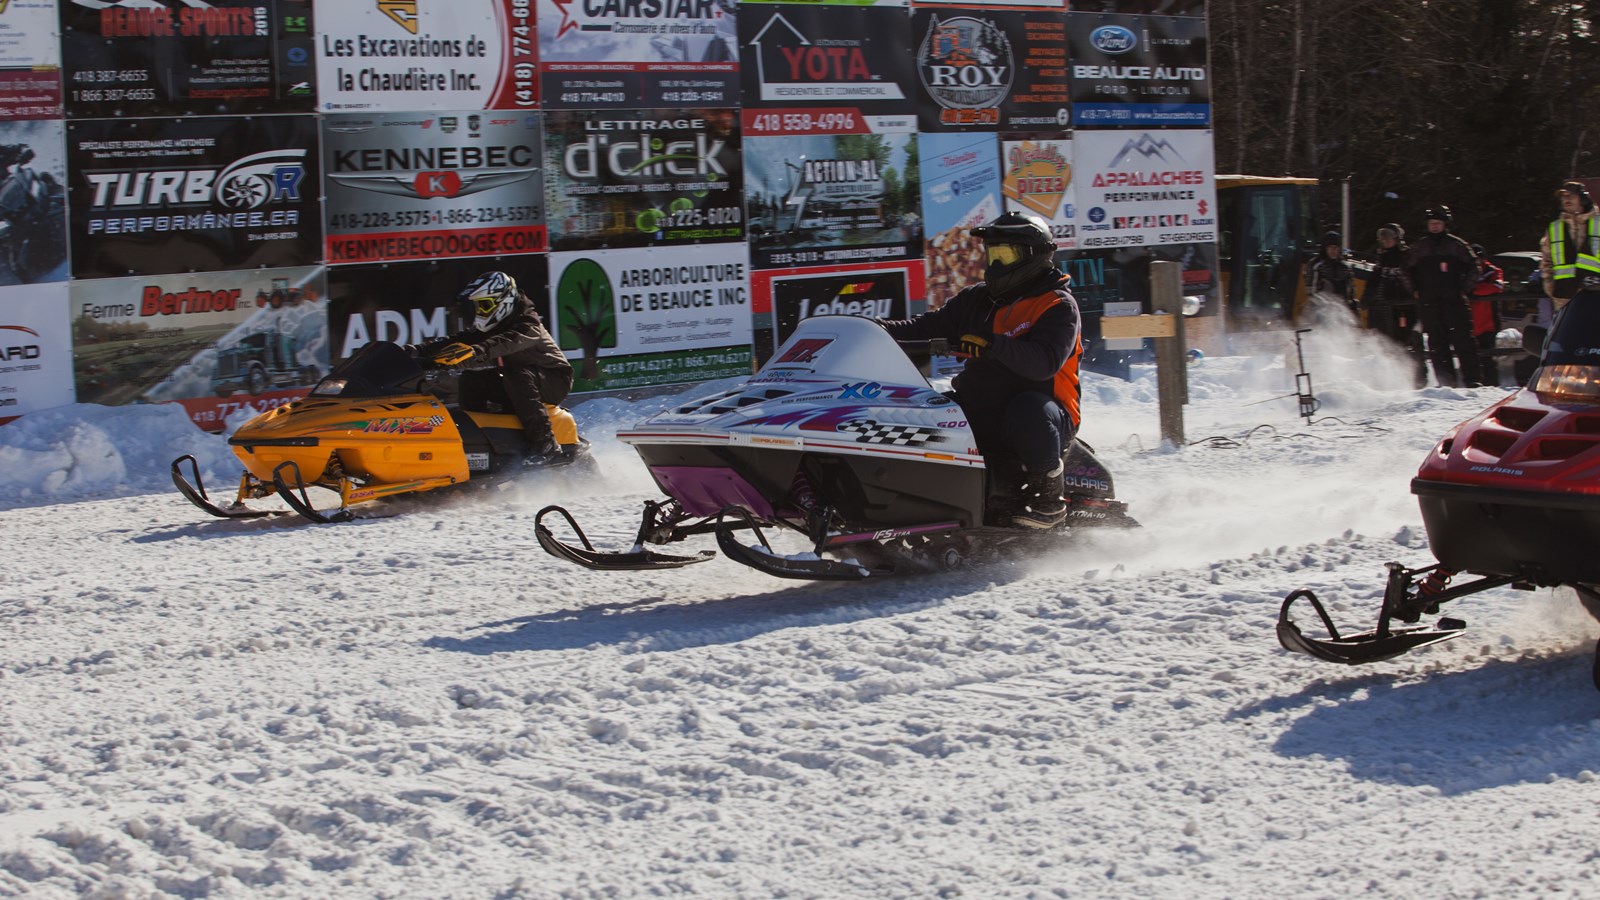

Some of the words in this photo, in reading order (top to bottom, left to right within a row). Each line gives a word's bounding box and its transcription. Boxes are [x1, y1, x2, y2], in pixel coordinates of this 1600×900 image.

[584, 0, 714, 18] CARSTAR
[101, 7, 174, 36] BEAUCE
[180, 7, 253, 36] SPORTS
[323, 34, 354, 57] Les
[358, 33, 461, 57] Excavations
[466, 34, 486, 57] de
[1099, 30, 1129, 48] Ford
[781, 47, 871, 81] YOTA
[74, 71, 95, 81] 418
[96, 70, 148, 81] 387-6655
[338, 67, 354, 91] la
[359, 67, 446, 91] Chaudière
[450, 69, 480, 91] Inc.
[929, 65, 1006, 87] ROY
[1073, 66, 1151, 79] BEAUCE
[1153, 67, 1205, 80] AUTO
[514, 63, 536, 105] (418)
[1095, 85, 1128, 94] FORD
[1141, 86, 1190, 95] LINCOLN
[81, 89, 103, 101] 866
[104, 88, 155, 101] 387-6655
[561, 93, 580, 102] 418
[662, 92, 679, 101] 418
[586, 119, 705, 131] LETTRAGE
[753, 114, 780, 131] 418
[783, 113, 854, 130] 558-4996
[334, 145, 532, 171] KENNEBEC
[565, 133, 728, 178] d'click
[428, 175, 447, 193] K
[1017, 172, 1065, 201] pizza
[1092, 171, 1204, 187] APPALACHES
[1104, 191, 1194, 202] PERFORMANCE
[331, 211, 429, 228] 418-228-5575
[676, 207, 741, 226] 225-6020
[331, 231, 542, 260] KENNEBECDODGE.COM
[1159, 231, 1213, 243] ST-GEORGES
[621, 263, 744, 288] ARBORICULTURE
[621, 295, 643, 312] DE
[650, 290, 713, 311] BEAUCE
[718, 287, 746, 305] INC
[83, 303, 135, 319] Ferme
[838, 382, 882, 399] XC
[193, 411, 216, 422] 418
[1470, 466, 1524, 475] POLARIS
[1070, 511, 1106, 519] XTRA-10
[872, 529, 895, 540] IFS
